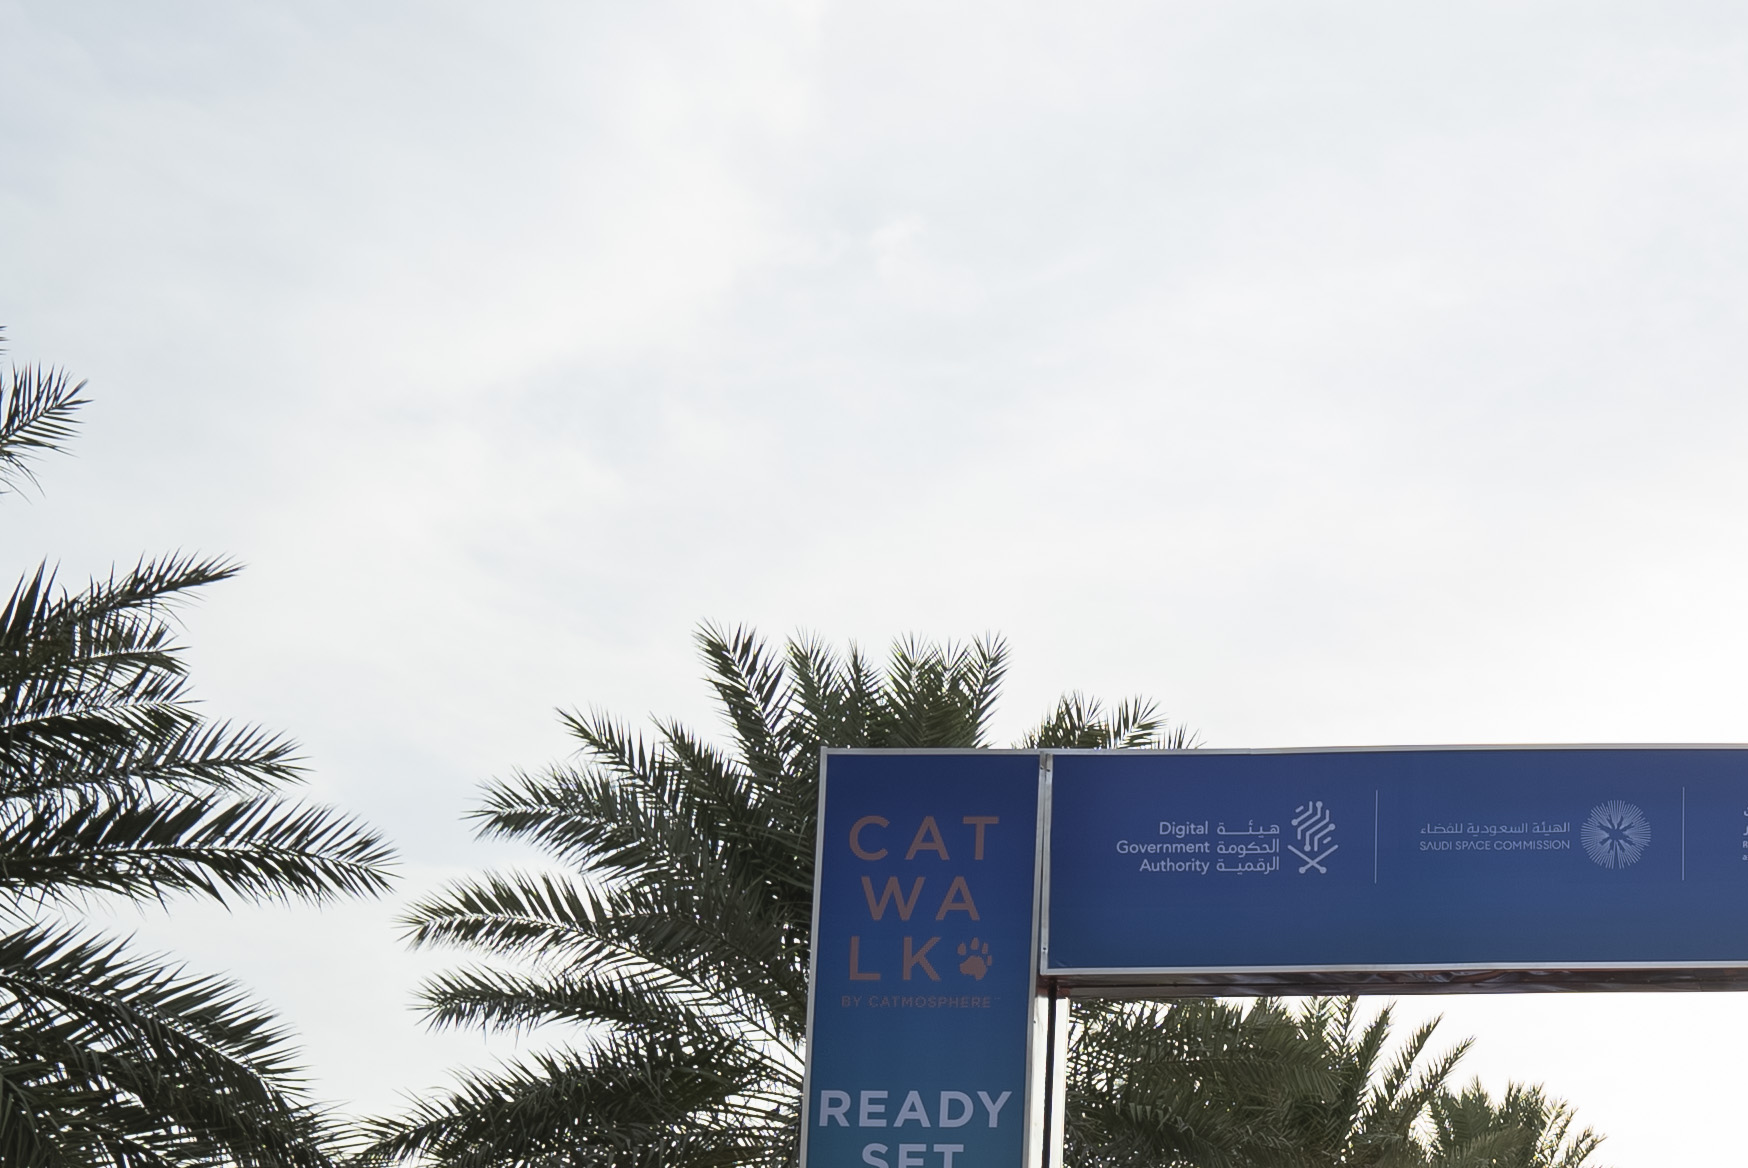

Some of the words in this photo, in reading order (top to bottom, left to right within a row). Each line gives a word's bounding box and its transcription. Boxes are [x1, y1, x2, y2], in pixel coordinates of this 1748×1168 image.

[1160, 820, 1209, 839] Digital
[1216, 820, 1280, 838] هيئة
[1420, 823, 1464, 834] للفضاء
[1466, 822, 1528, 837] السعودية
[1532, 822, 1570, 837] الهيئة
[849, 815, 1000, 861] CAT
[1116, 840, 1210, 854] Government
[1420, 840, 1452, 851] SAUDI
[1455, 840, 1490, 850] SPACE
[1493, 839, 1570, 850] COMMISSION
[1216, 838, 1280, 858] الحكومة
[1139, 858, 1210, 876] Authority
[1216, 856, 1280, 876] الرقمية
[860, 876, 980, 920] WA
[849, 936, 941, 981] LK
[841, 995, 862, 1008] BY
[867, 995, 992, 1008] CATMOSPHERE
[818, 1090, 1012, 1128] READY
